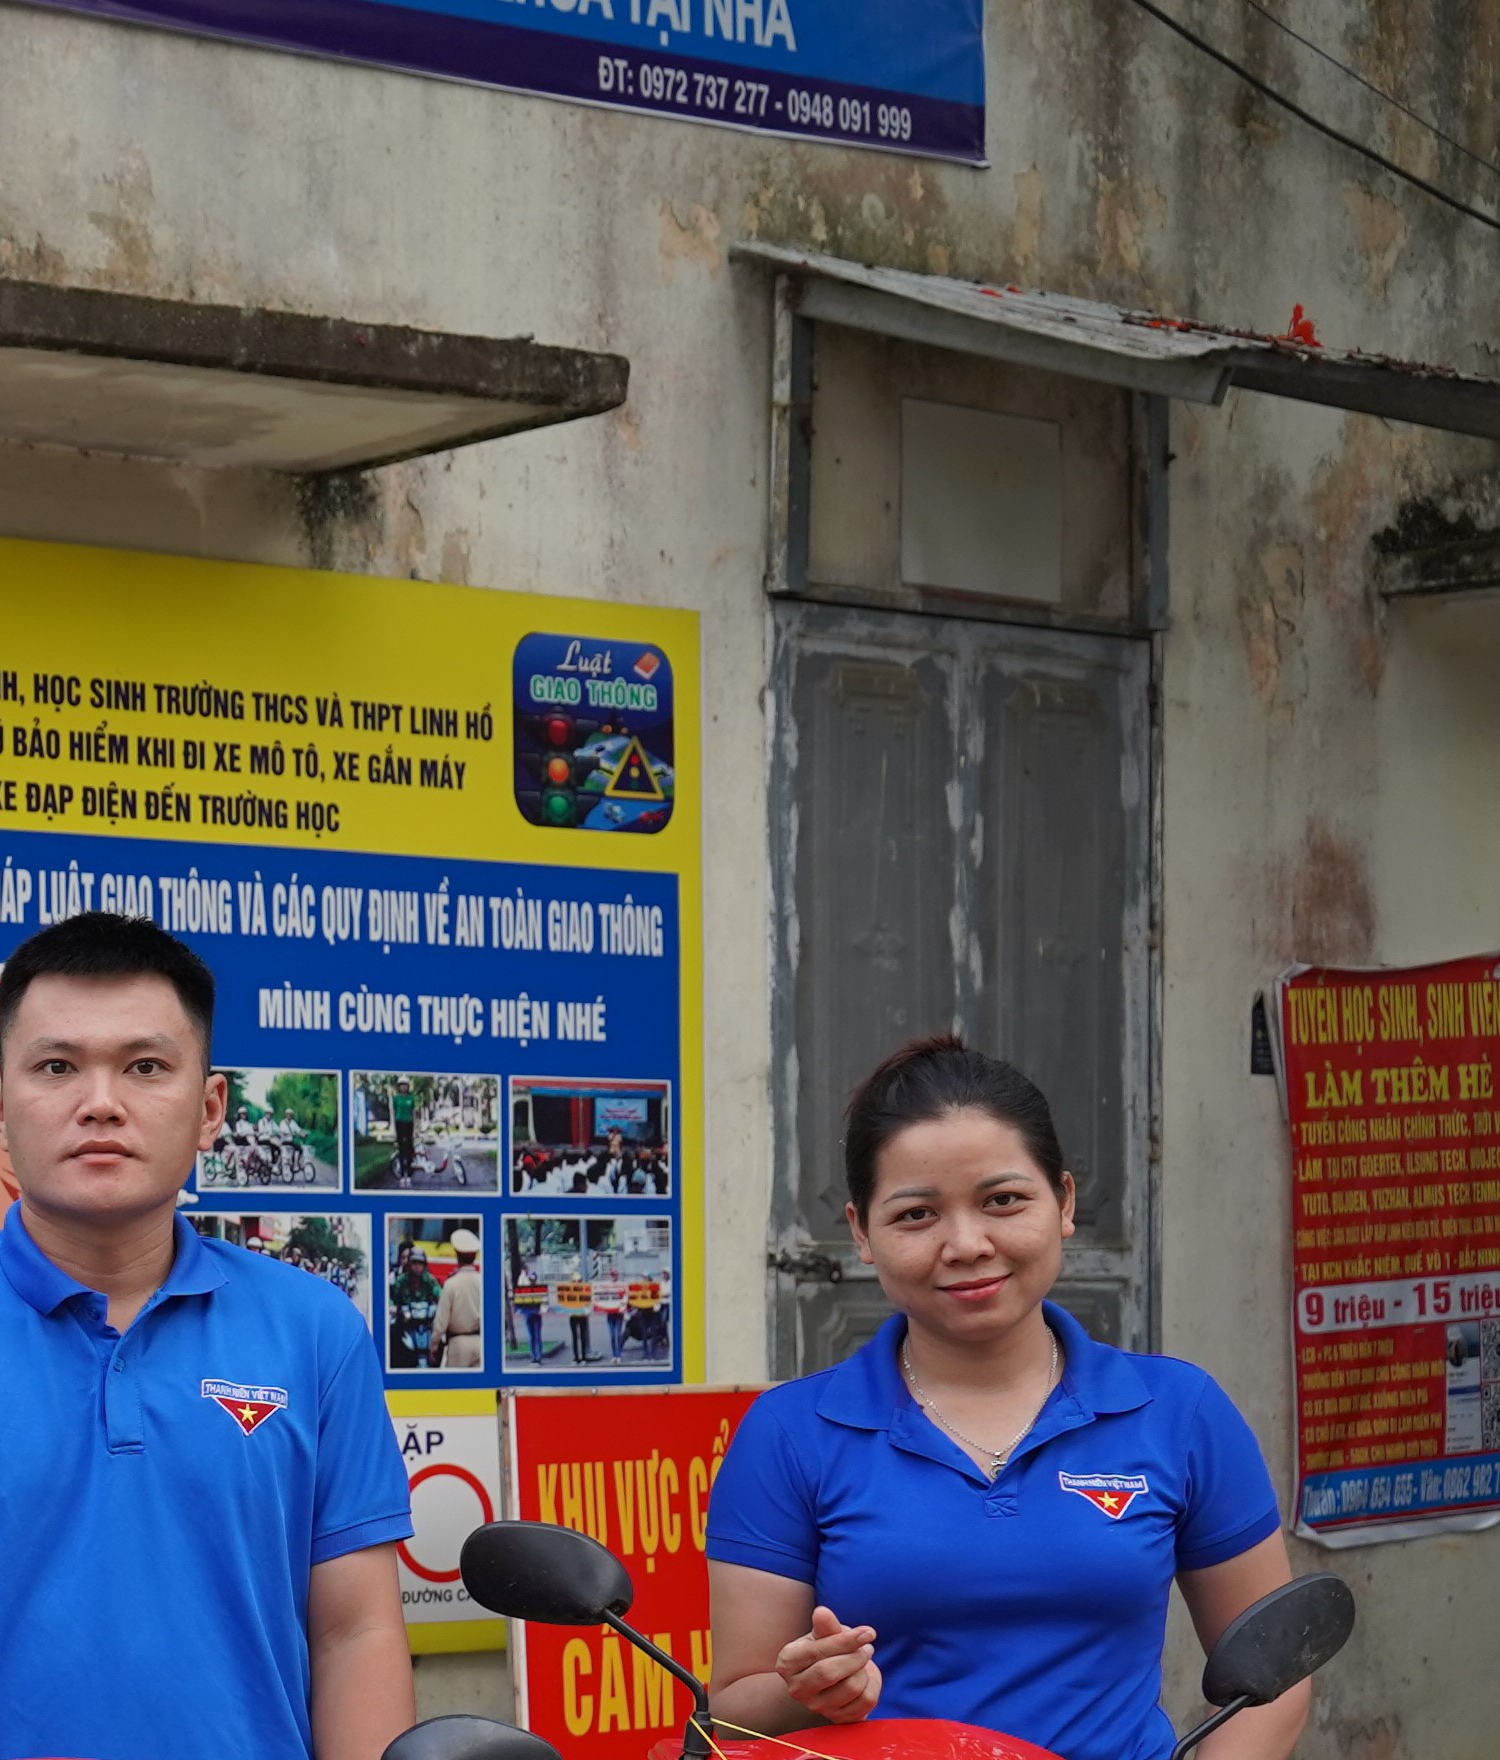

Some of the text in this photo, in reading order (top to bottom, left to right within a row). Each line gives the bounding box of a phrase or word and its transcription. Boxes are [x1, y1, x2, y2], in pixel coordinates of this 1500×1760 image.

[598, 55, 635, 95] ĐT:
[639, 64, 688, 105] 0972
[694, 72, 728, 111] 737
[734, 79, 770, 118] 277
[787, 88, 834, 128] 0948
[838, 98, 871, 134] 091
[877, 103, 912, 142] 999
[530, 674, 657, 711] GIAO THÔNG
[556, 640, 612, 678] Luật
[33, 670, 81, 714] HỌC
[89, 677, 146, 712] SINH
[154, 679, 245, 720] TRƯỜNG
[252, 691, 308, 725] THCS
[316, 692, 343, 729] VÀ
[350, 701, 402, 734] THPT
[410, 707, 457, 739] LINH
[465, 701, 493, 742] HỒ
[258, 980, 607, 1047] MÌNH CÙNG THỰC HIỆN NHÉ
[1288, 972, 1339, 1045] TUYỂN
[1341, 985, 1374, 1055] HỌC
[1379, 984, 1424, 1047] SINH,
[1427, 983, 1465, 1039] SINH
[1305, 1052, 1494, 1109] LÀM THÊM HÈ
[1305, 1292, 1324, 1325] 9
[1334, 1293, 1385, 1329] triệu
[1413, 1281, 1450, 1316] 15
[613, 1448, 682, 1573] VỰC
